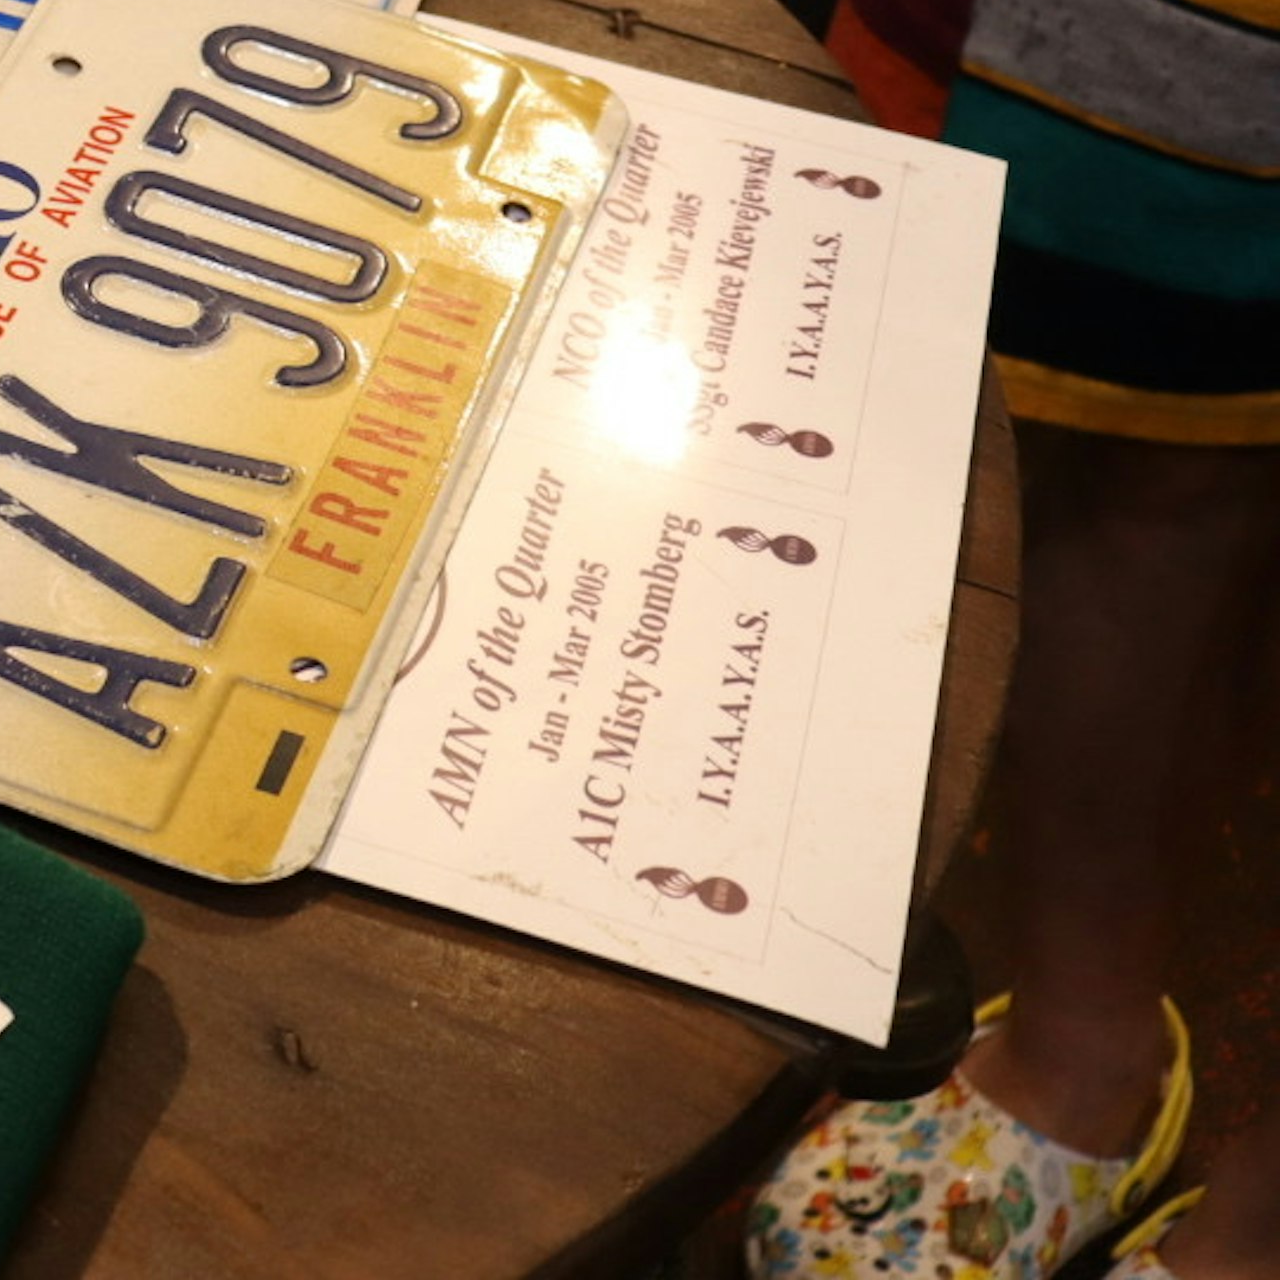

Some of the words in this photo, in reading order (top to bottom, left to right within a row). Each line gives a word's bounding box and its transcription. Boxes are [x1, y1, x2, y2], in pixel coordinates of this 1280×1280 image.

[4, 240, 48, 283] OF
[40, 106, 136, 228] AVIATION
[60, 24, 464, 390] 9079
[603, 122, 662, 227] Quarter
[666, 190, 703, 240] 2005
[590, 227, 632, 277] the
[686, 273, 745, 375] Candace
[288, 282, 487, 578] FRANKLIN
[495, 466, 566, 602] Quarter
[476, 606, 526, 667] the
[566, 559, 611, 623] 2005
[619, 511, 702, 667] Stomberg
[466, 658, 517, 712] of
[547, 624, 597, 688] Mar
[528, 710, 570, 763] Jan
[591, 670, 662, 772] Misty
[696, 608, 771, 809] I.Y.A.A.Y.A.S.
[425, 711, 492, 831] AMN
